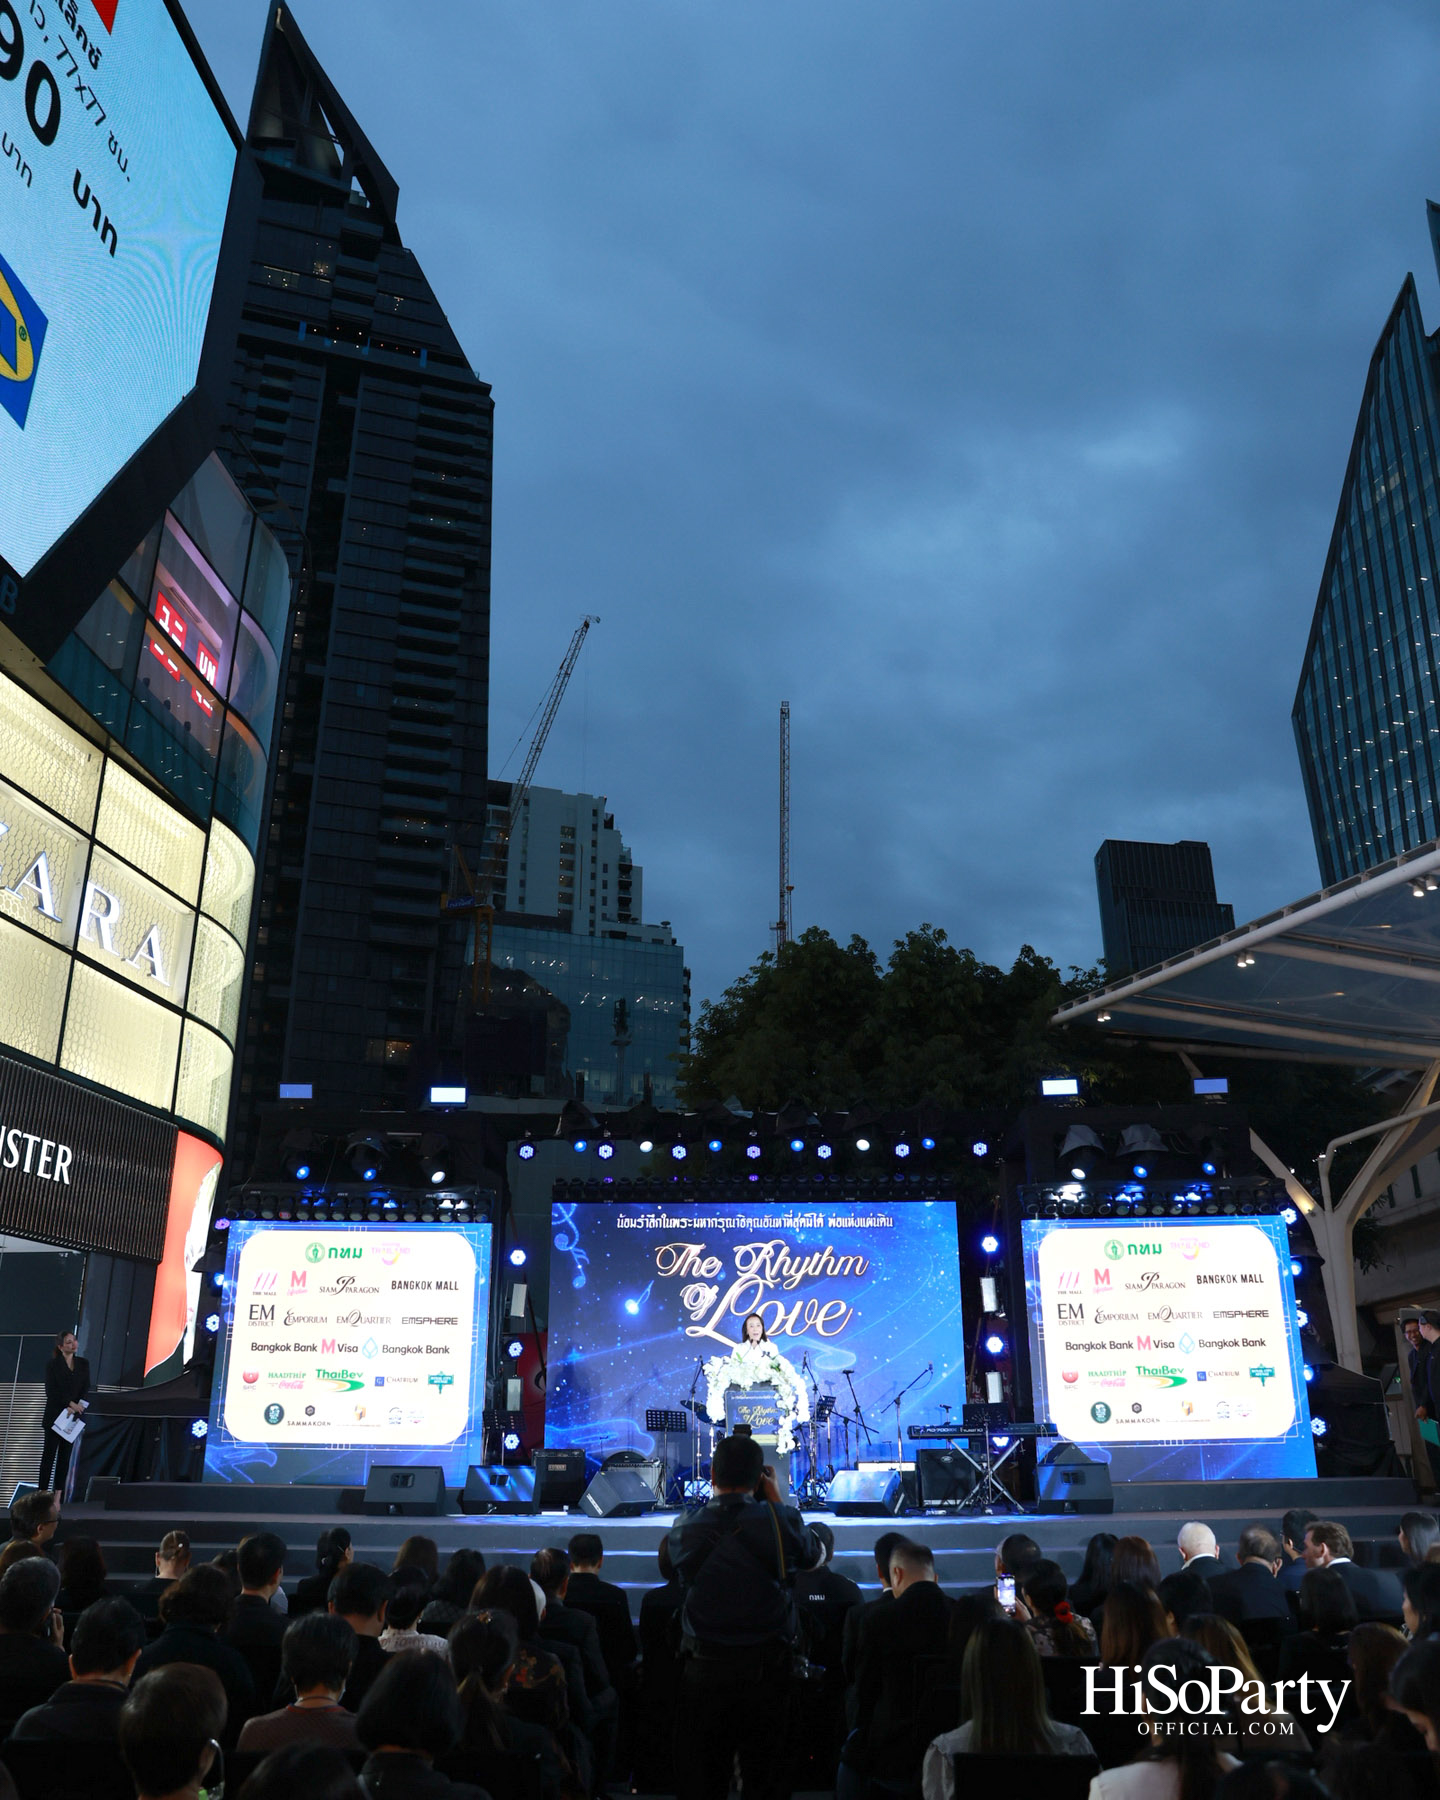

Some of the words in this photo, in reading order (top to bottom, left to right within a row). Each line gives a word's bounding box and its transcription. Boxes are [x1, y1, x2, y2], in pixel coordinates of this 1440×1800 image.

[56, 34, 107, 126] 77x77
[108, 130, 130, 182] ซม.
[2, 131, 33, 188] บาท
[73, 168, 118, 258] บาท
[328, 1247, 363, 1259] กทม
[1127, 1243, 1163, 1255] กทม
[654, 1242, 723, 1279] The
[733, 1239, 870, 1290] Rhythm
[290, 1270, 307, 1288] M
[1094, 1268, 1111, 1286] M
[1196, 1274, 1238, 1285] BANGKOK
[1240, 1274, 1264, 1284] MALL
[391, 1280, 433, 1290] BANGKOK
[435, 1281, 459, 1291] MALL
[1125, 1282, 1143, 1290] SIAM
[249, 1304, 275, 1320] EM
[685, 1273, 853, 1350] Love
[1057, 1303, 1085, 1319] EM
[1213, 1310, 1270, 1318] EMSPHERE
[401, 1317, 459, 1325] EMSPHERE
[250, 1342, 292, 1353] Bangkok
[293, 1343, 318, 1352] Bank
[337, 1343, 359, 1353] Visa
[382, 1344, 423, 1356] Bangkok
[425, 1345, 450, 1354] Bank
[1065, 1341, 1107, 1352] Bangkok
[1109, 1340, 1134, 1350] Bank
[1153, 1339, 1175, 1349] Visa
[1198, 1338, 1240, 1350] Bangkok
[1241, 1338, 1266, 1347] Bank
[315, 1368, 364, 1379] ThaiBev
[1135, 1365, 1185, 1376] ThaiBev
